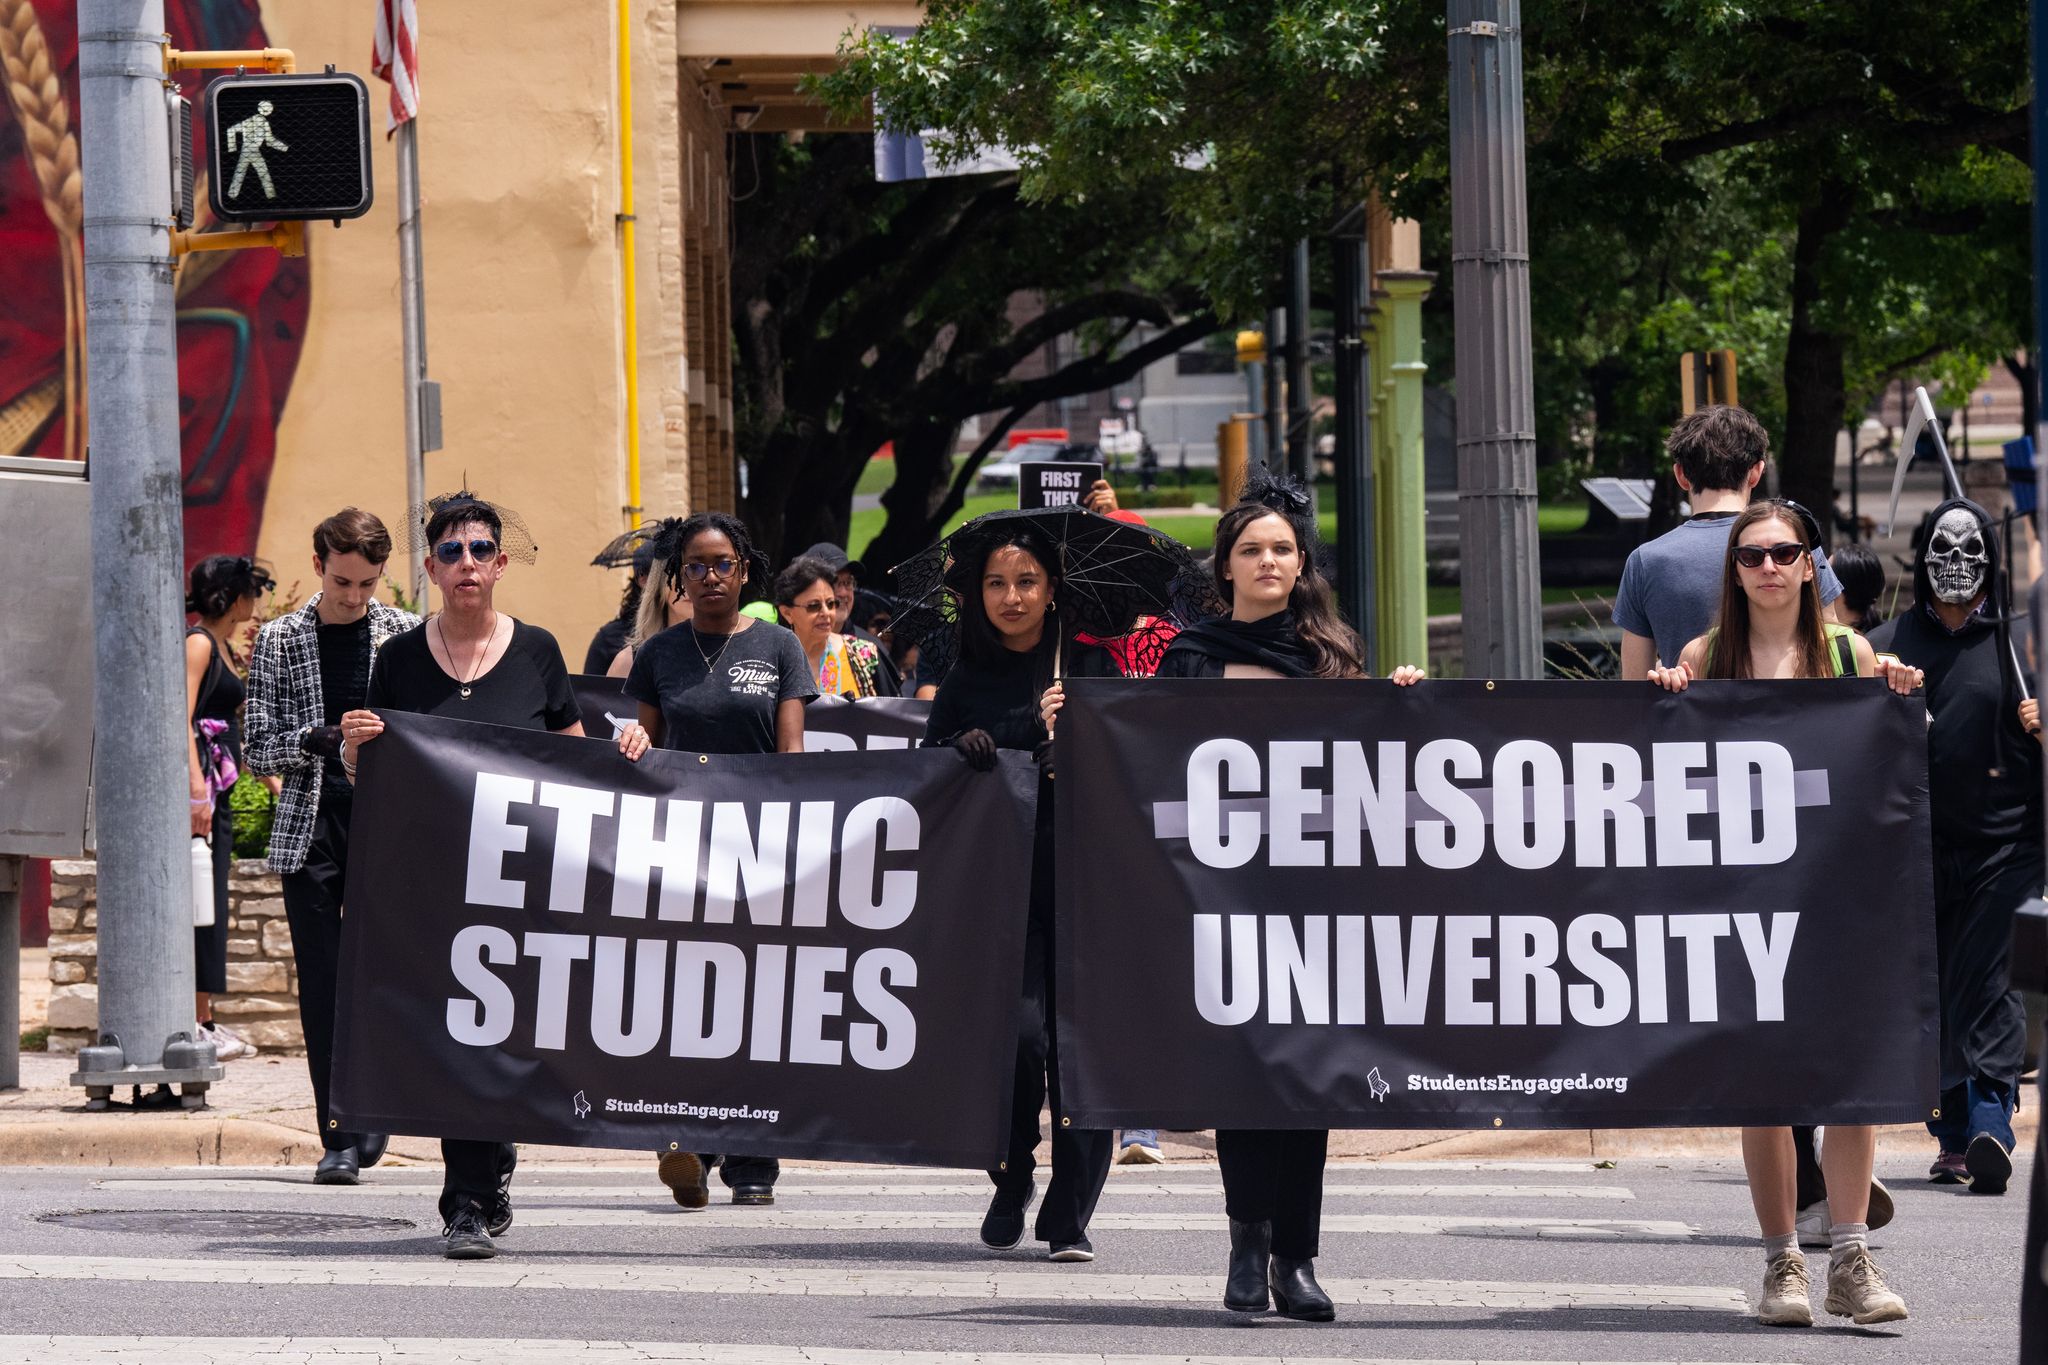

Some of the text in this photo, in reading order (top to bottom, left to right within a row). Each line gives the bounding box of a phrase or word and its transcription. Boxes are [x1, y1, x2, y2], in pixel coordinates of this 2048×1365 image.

[1040, 471, 1082, 488] FIRST
[1042, 490, 1079, 507] THEY
[728, 666, 780, 684] Miller
[1186, 738, 1797, 870] CENSORED
[465, 771, 921, 930] ETHNIC
[1193, 911, 1801, 1027] UNIVERSITY
[446, 924, 918, 1071] STUDIES
[1406, 1072, 1629, 1095] StudentsEngaged.org
[604, 1097, 781, 1124] StudentsEngaged.org
